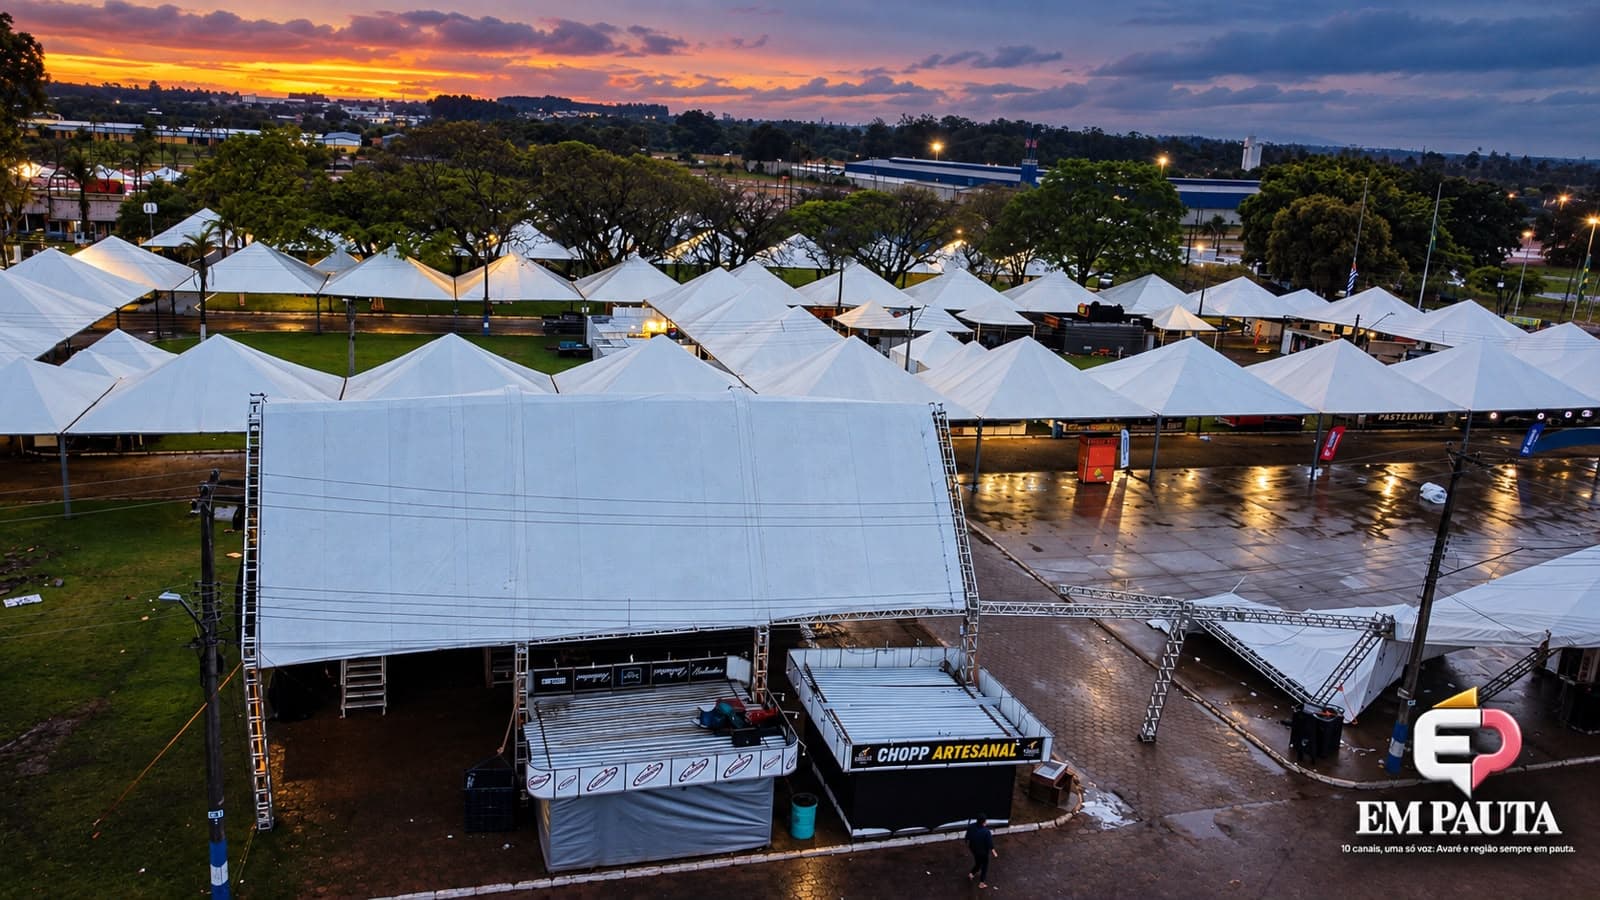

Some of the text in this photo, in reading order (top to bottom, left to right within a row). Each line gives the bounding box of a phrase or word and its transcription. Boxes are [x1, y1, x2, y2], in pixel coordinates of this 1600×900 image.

[1377, 413, 1434, 421] PASTELARIA
[877, 746, 930, 763] CHOPP
[931, 743, 1018, 761] ARTESANAL
